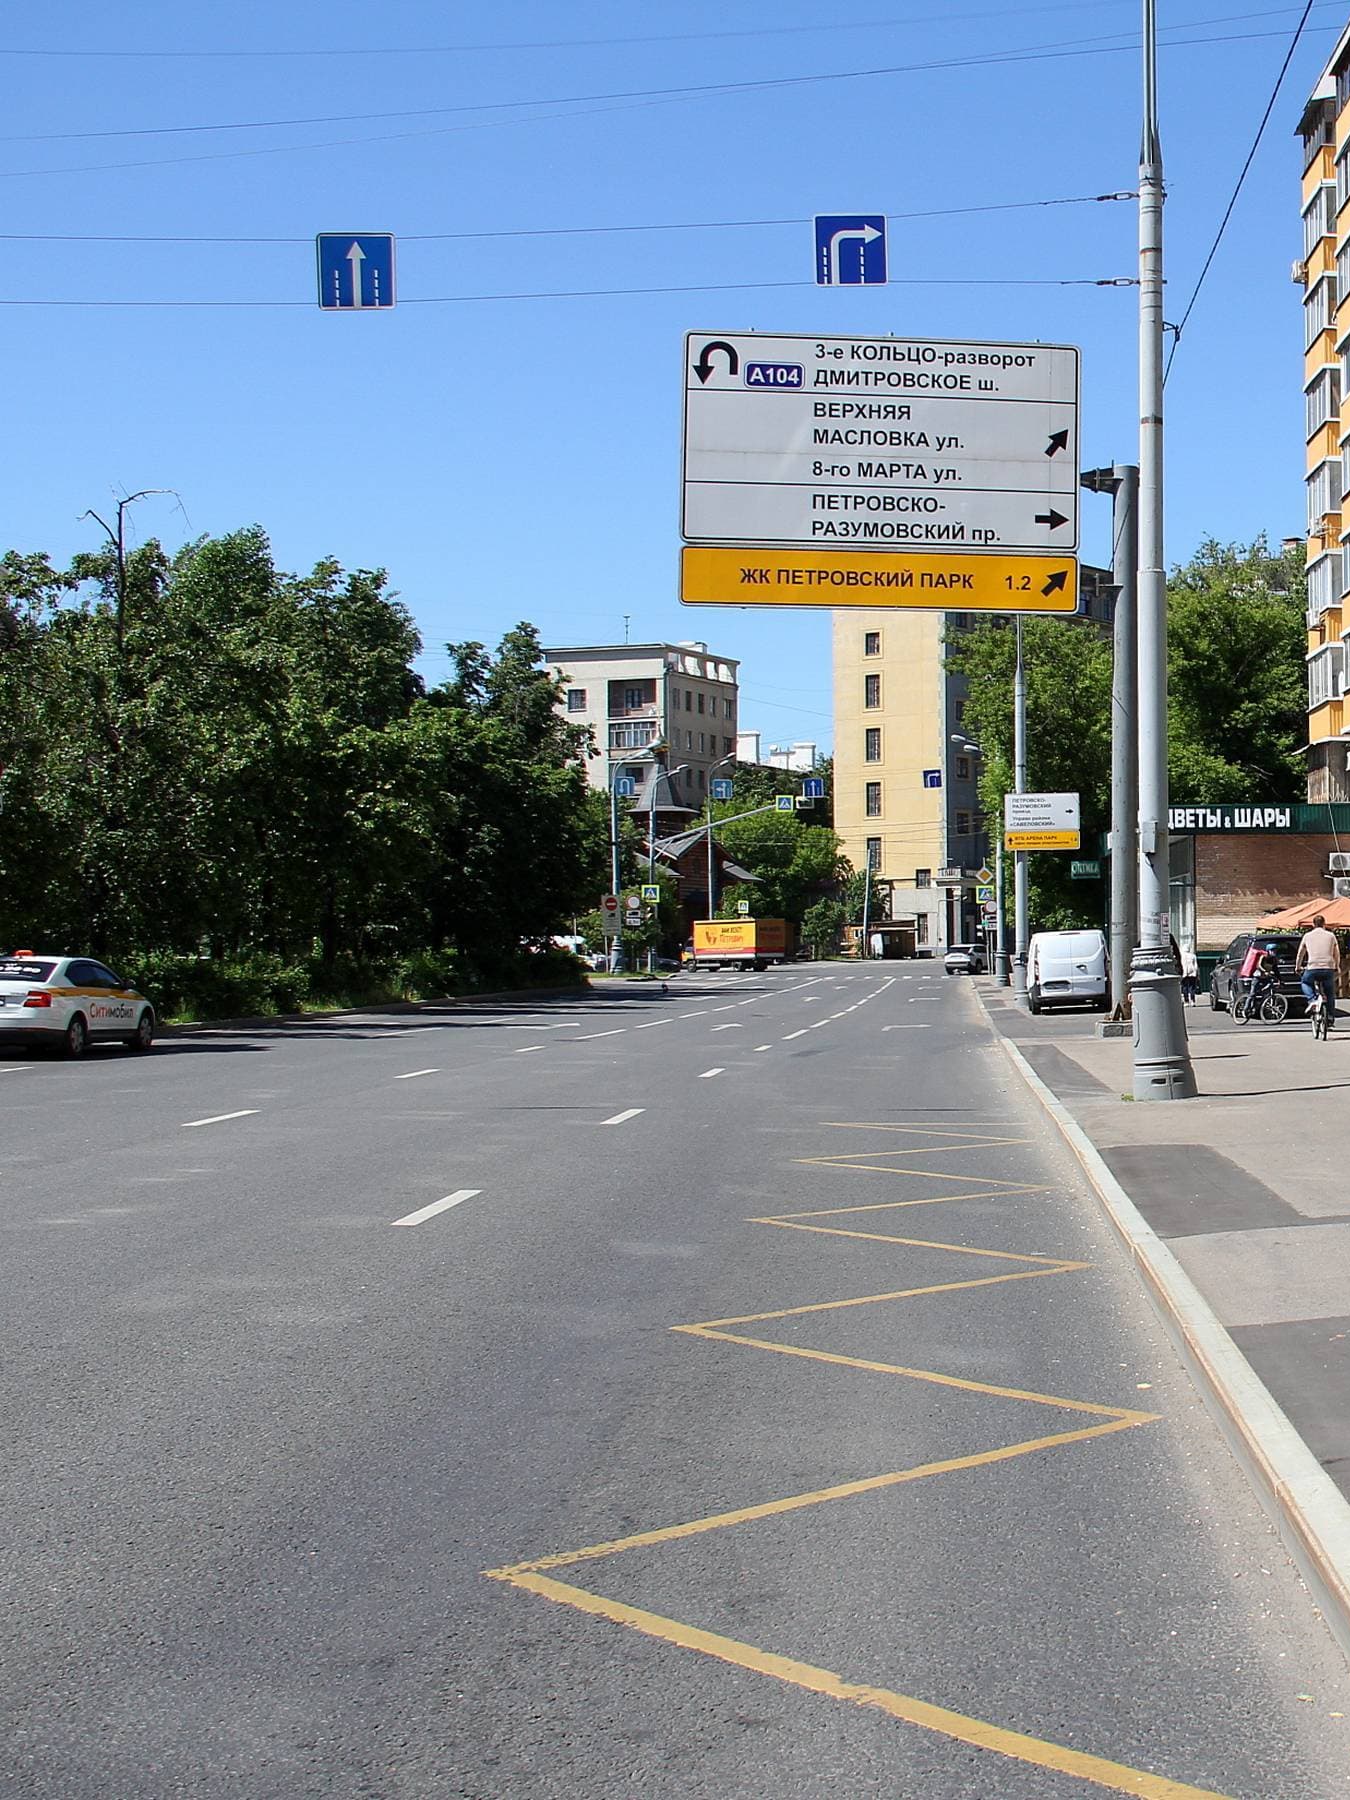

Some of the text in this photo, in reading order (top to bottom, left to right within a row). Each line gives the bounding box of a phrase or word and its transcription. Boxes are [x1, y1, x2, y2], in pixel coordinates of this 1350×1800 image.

[815, 344, 1036, 370] 3-е КОЛЬЦО-разворот
[750, 367, 800, 384] А104
[814, 369, 999, 391] ДМИТРОВСКОЕ ш.
[814, 402, 911, 420] ВЕРХНЯЯ
[813, 429, 964, 451] МАСЛОВКА ул.
[812, 461, 962, 484] 8-го МАРТА ул.
[812, 494, 946, 513] ПЕТРОВСКО-
[811, 520, 1001, 544] РАЗУМОВСКИЙ пр.
[740, 567, 1031, 591] ЖК ПЕТРОВСКИЙ ПАРК 1.2
[1224, 816, 1231, 828] &
[1234, 808, 1290, 828] ШАРЫ
[90, 1002, 134, 1018] Ситимобил
